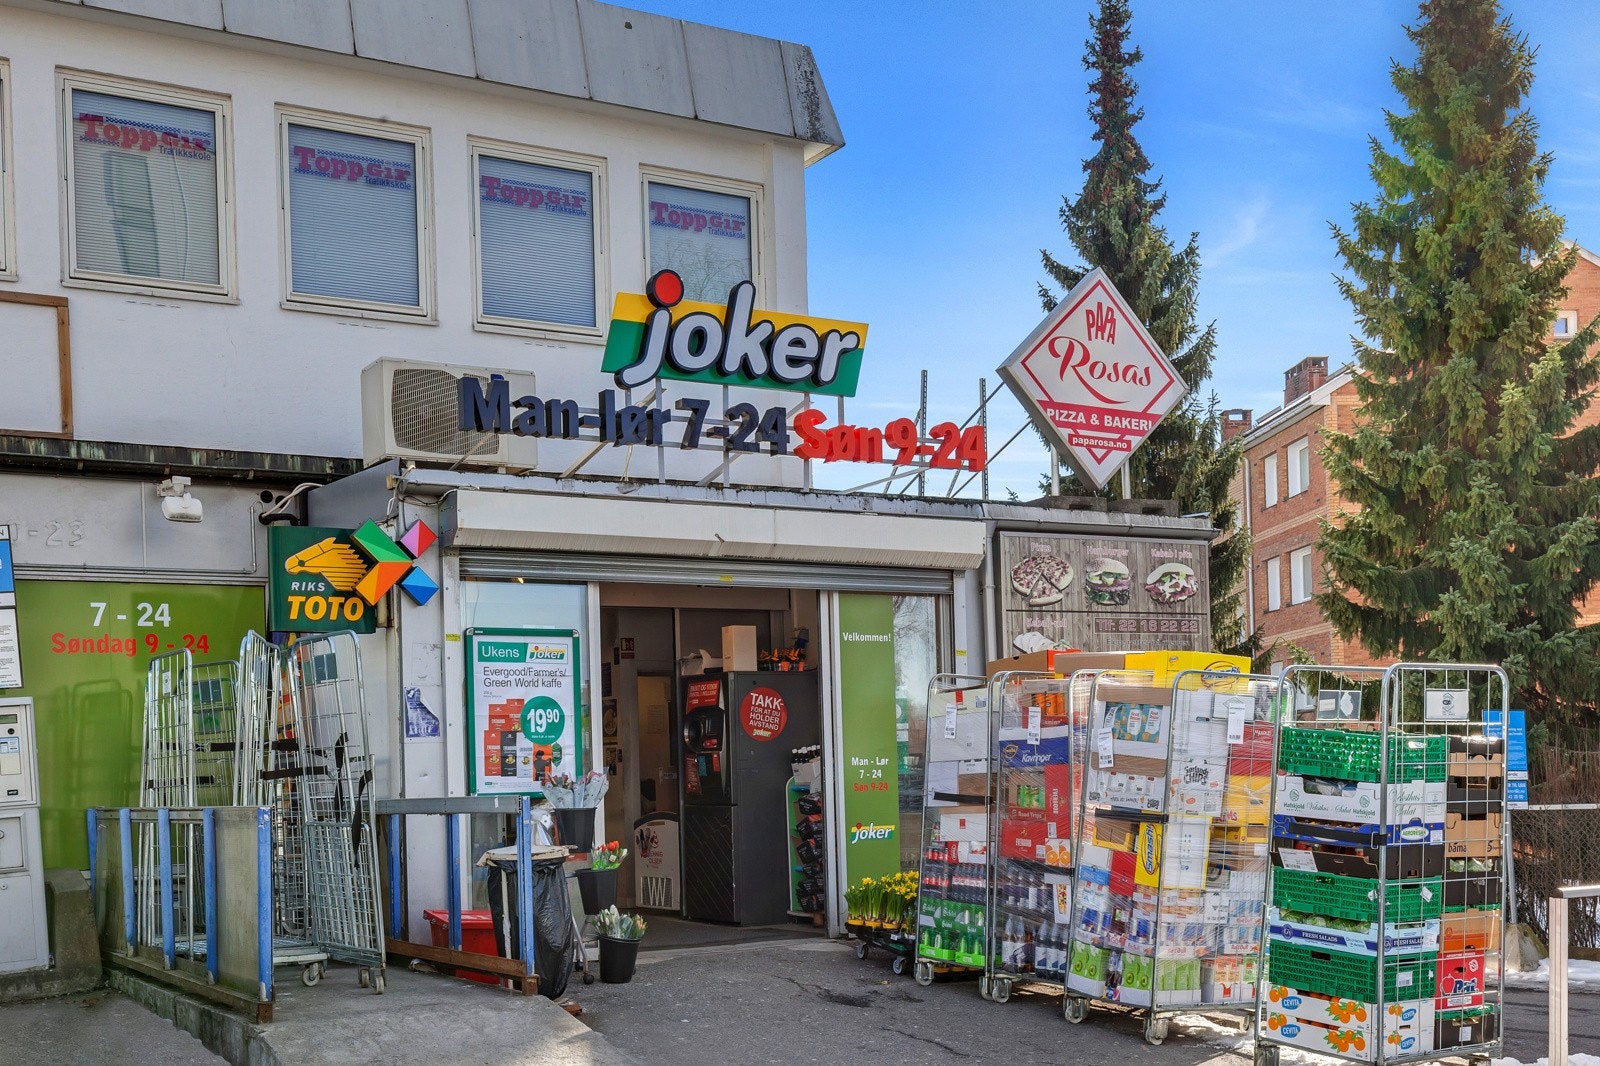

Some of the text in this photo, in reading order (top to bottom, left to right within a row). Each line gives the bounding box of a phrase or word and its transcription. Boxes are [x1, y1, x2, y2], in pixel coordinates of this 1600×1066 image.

[159, 144, 211, 161] Trafikkskole
[364, 175, 412, 191] Trafikkskole
[544, 202, 587, 217] Trafikkskole
[707, 226, 746, 240] Trafikkskole
[615, 268, 860, 389] joker
[1086, 301, 1117, 345] PAPA
[1048, 336, 1151, 405] Rosas
[1047, 408, 1152, 431] PIZZA & BAKERI
[676, 397, 790, 456] 7-24
[793, 408, 883, 465] Søn
[885, 417, 988, 472] 9-24
[1072, 436, 1128, 449] paparosa.no
[290, 581, 325, 593] RIKS
[90, 602, 106, 627] 7
[137, 602, 171, 627] 24
[287, 595, 364, 622] TOTO
[1119, 620, 1137, 631] 22
[1160, 620, 1178, 631] 22
[1181, 620, 1198, 632] 22
[843, 632, 892, 642] Velkommen!
[51, 633, 137, 657] Søndag
[145, 634, 158, 654] 9
[182, 634, 209, 654] 24
[482, 645, 563, 661] Ukens joker
[483, 678, 562, 688] Green World kaffe
[749, 712, 780, 724] HOLDER
[749, 720, 779, 731] AVSTAND
[851, 757, 869, 767] Man
[876, 757, 889, 767] Lør
[859, 770, 865, 778] 7
[872, 770, 882, 779] 24
[854, 783, 869, 792] Søn
[1283, 801, 1305, 810] Hafskjold
[1352, 808, 1376, 817] Hafskjold
[852, 822, 893, 844] joker
[1302, 931, 1318, 939] FRESH
[1318, 934, 1338, 943] SALADS
[1283, 998, 1301, 1007] CEVITA
[1402, 1009, 1416, 1020] CEVITA
[1282, 1027, 1299, 1036] CEVITA
[1401, 1038, 1415, 1049] CEVITA
